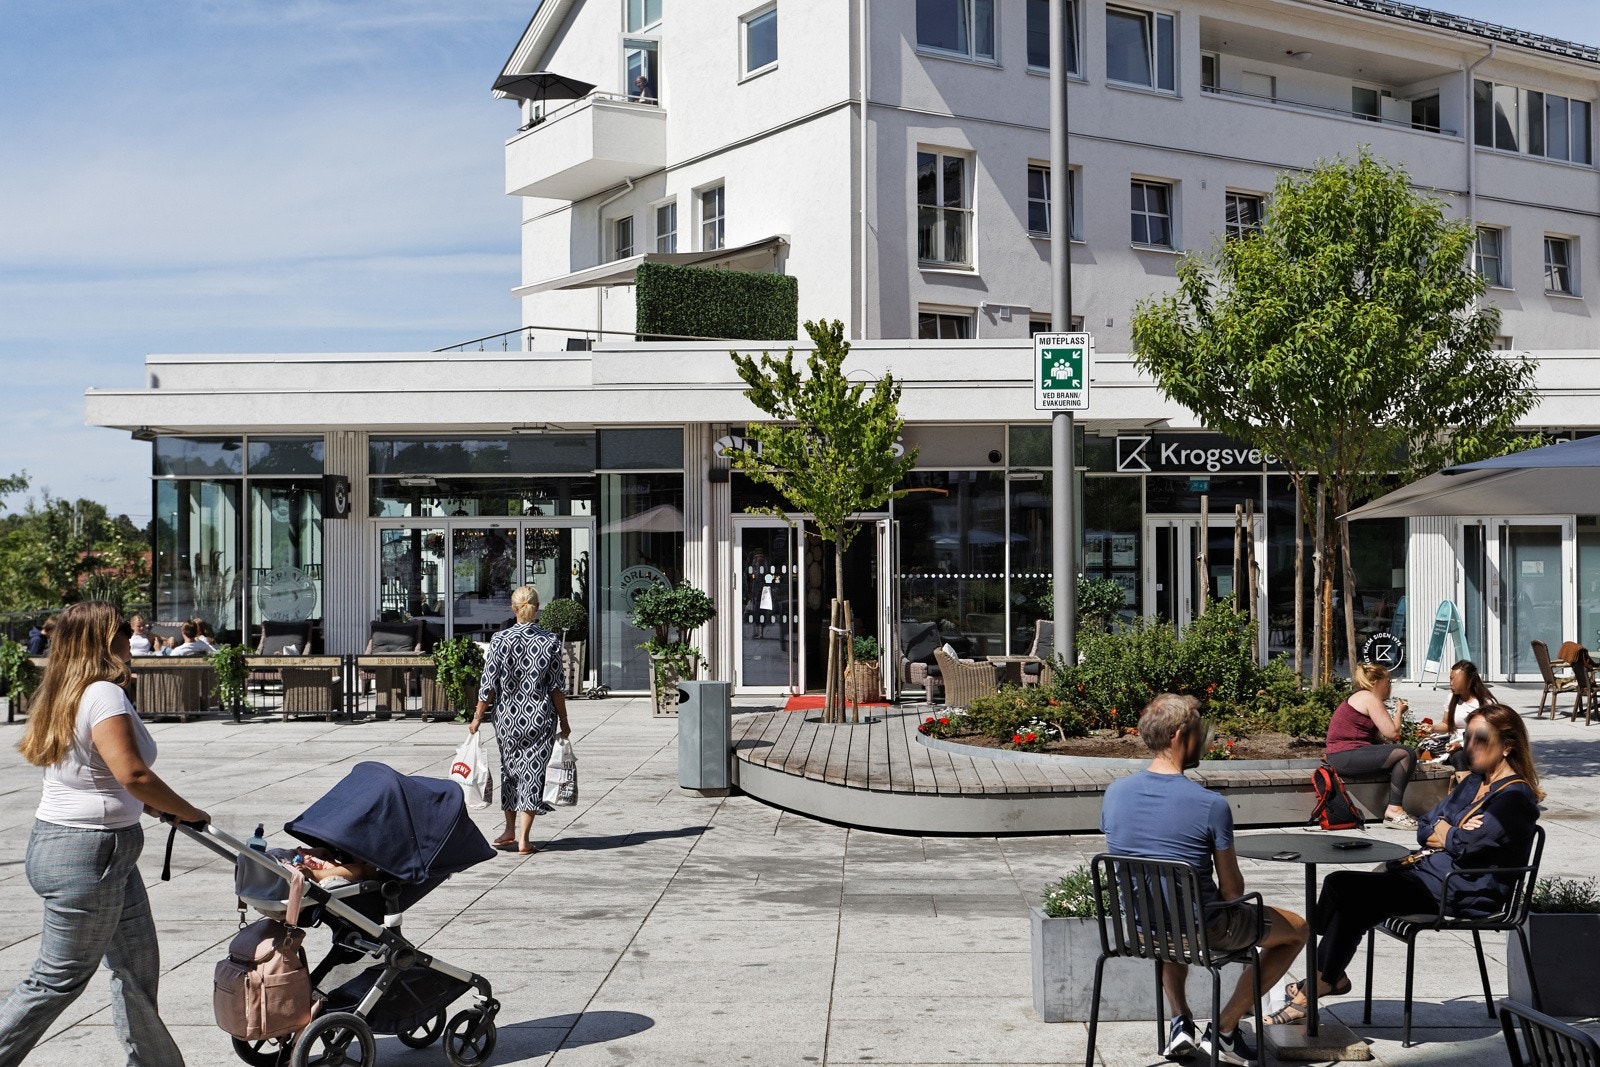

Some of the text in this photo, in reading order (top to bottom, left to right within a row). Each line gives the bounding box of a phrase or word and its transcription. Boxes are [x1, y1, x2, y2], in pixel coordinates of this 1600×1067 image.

[1039, 336, 1085, 345] MØTEPLASS
[1042, 399, 1081, 407] EVAKUERING
[1160, 442, 1293, 472] Krogsvee
[1373, 632, 1391, 640] SIDEN
[453, 764, 469, 775] MENY
